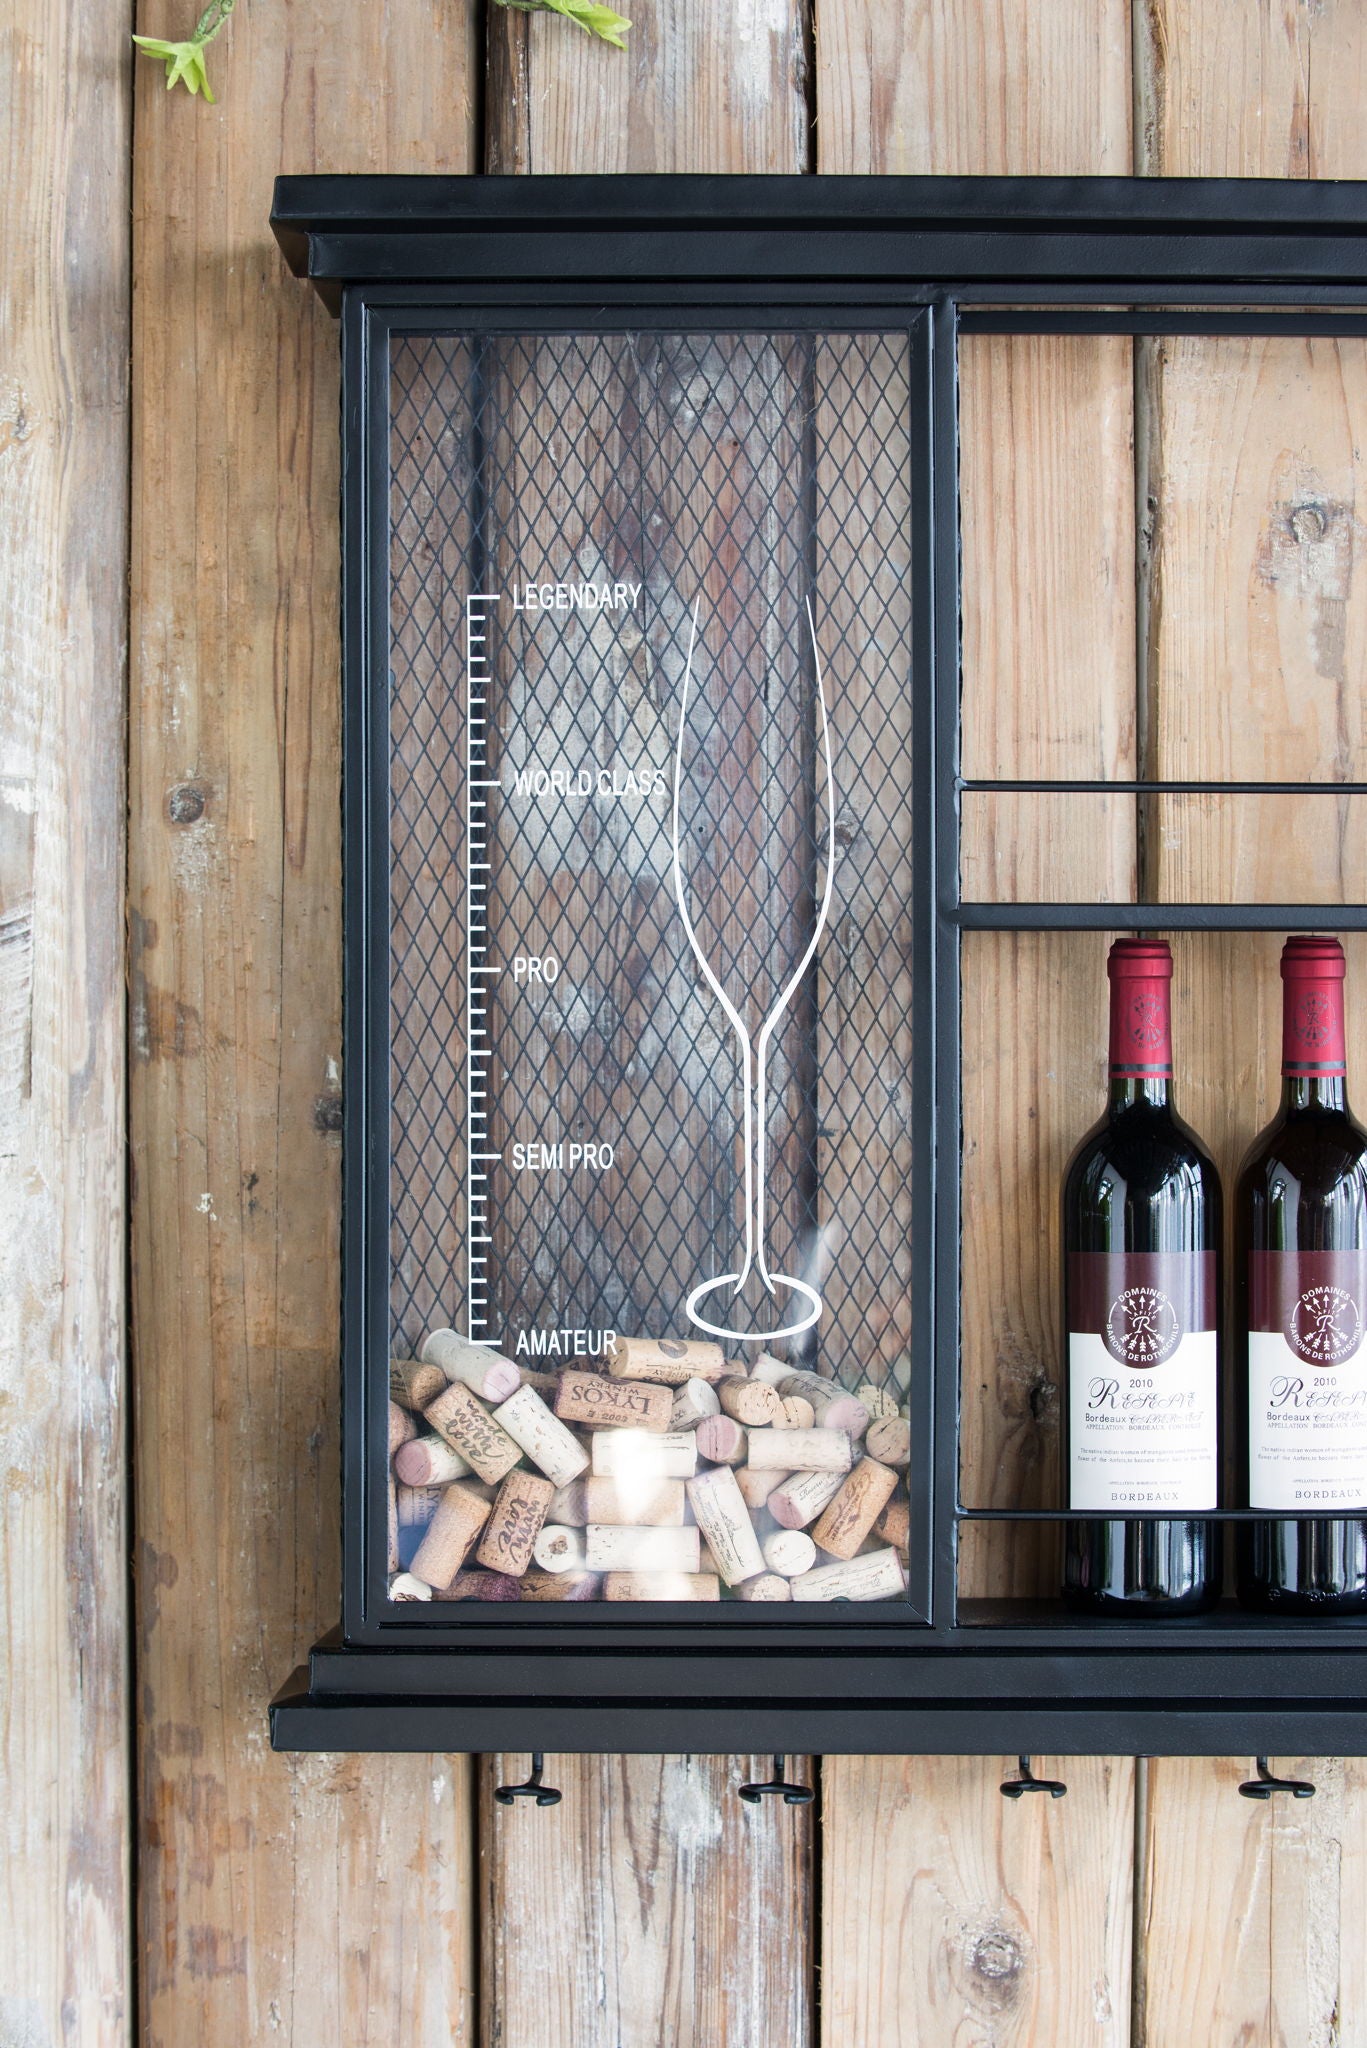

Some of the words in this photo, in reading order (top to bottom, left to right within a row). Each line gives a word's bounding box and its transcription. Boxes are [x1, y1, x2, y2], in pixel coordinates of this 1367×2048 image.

[513, 583, 642, 610] LEGENDARY
[514, 769, 592, 796] WORLD
[597, 769, 666, 796] CLASS
[514, 956, 558, 983] PRO
[512, 1143, 563, 1170] SEMI
[569, 1143, 614, 1170] PRO
[1117, 1287, 1168, 1302] DOMAINES
[1301, 1286, 1351, 1302] DOMAINES
[515, 1329, 618, 1356] AMATEUR
[1106, 1322, 1127, 1357] BARONS
[1127, 1352, 1140, 1362] DE
[1140, 1322, 1180, 1362] ROTHSCHILD
[1289, 1322, 1312, 1356] BARONS
[1311, 1352, 1324, 1361] DE
[1324, 1321, 1363, 1361] ROTHSCHILD
[1129, 1379, 1153, 1388] 2010
[1313, 1377, 1337, 1387] 2010
[571, 1385, 651, 1416] LYKOS
[1085, 1412, 1127, 1423] Bordeaux
[1266, 1411, 1310, 1421] Bordeaux
[1111, 1492, 1179, 1501] BORDEAUX
[1295, 1489, 1362, 1499] BORDEAUX
